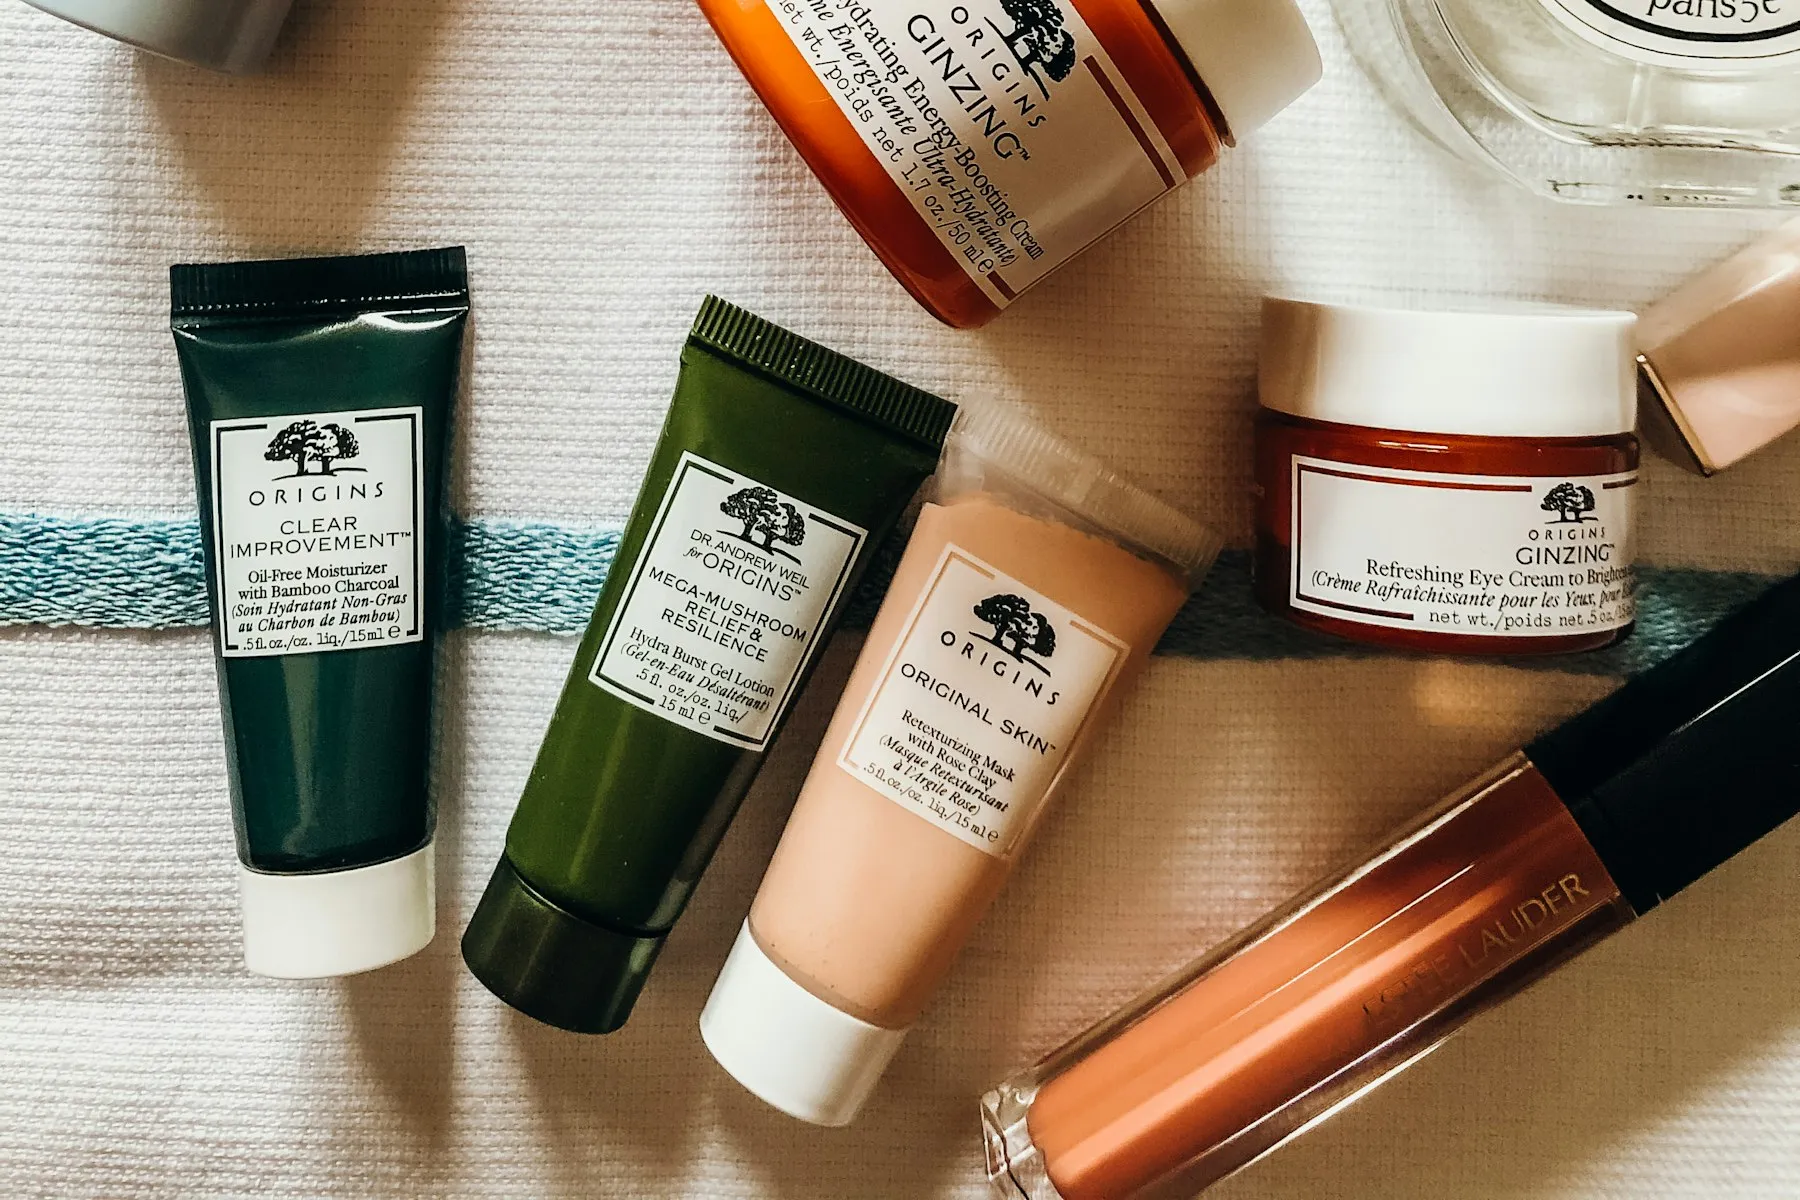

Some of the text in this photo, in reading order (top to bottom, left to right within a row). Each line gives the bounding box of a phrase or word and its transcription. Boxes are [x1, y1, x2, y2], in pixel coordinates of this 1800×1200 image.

[950, 6, 1047, 128] ORIGINS
[802, 26, 874, 123] wt./poids
[872, 126, 905, 163] net
[901, 162, 931, 192] 1.7
[827, 22, 917, 136] Énergisante
[913, 136, 1020, 268] Ultra-Hydratante)
[902, 76, 1016, 227] Energy-Boosting
[1010, 219, 1044, 260] Cream
[249, 482, 384, 506] ORIGINS
[280, 516, 358, 535] CLEAR
[683, 546, 704, 559] for
[1528, 526, 1605, 541] ORIGINS
[248, 562, 388, 584] Oil-Free Moisturizer
[690, 528, 810, 589] DR. ANDREW WEIL
[1366, 558, 1464, 588] Refreshing
[1469, 569, 1504, 590] Eye
[1508, 570, 1564, 587] Cream
[1568, 572, 1584, 586] to
[232, 593, 408, 619] (Soin Hydratant Non-Gras
[238, 575, 400, 600] with Bamboo Charcoal
[649, 566, 808, 642] MEGA-MUSHROOM
[1311, 569, 1362, 593] (Crème
[1365, 579, 1496, 607] Rafraîchissante
[1497, 593, 1538, 611] pour
[1541, 591, 1560, 608] les
[238, 609, 401, 633] au Charbon de Bambou)
[661, 608, 769, 662] RESILIENCE
[685, 601, 763, 643] RELIEF &
[1429, 610, 1461, 624] net
[1467, 611, 1552, 631] wt./poids
[1559, 612, 1584, 625] net
[620, 642, 770, 713] (Gel-en-Eau Désaltérant)
[629, 626, 775, 698] Hydra Burst Gel Lotion
[940, 630, 1060, 705] ORIGINS
[658, 694, 677, 711] 15
[668, 683, 711, 709] oz./oz.
[901, 662, 993, 725] ORIGINAL
[879, 734, 1010, 813] (Masque Retexturisant
[901, 709, 1017, 783] Retexturizing Mask
[908, 731, 997, 791] with Rose Clay
[892, 758, 904, 772] à
[949, 790, 981, 816] Rose)
[1458, 873, 1590, 969] LAUDER
